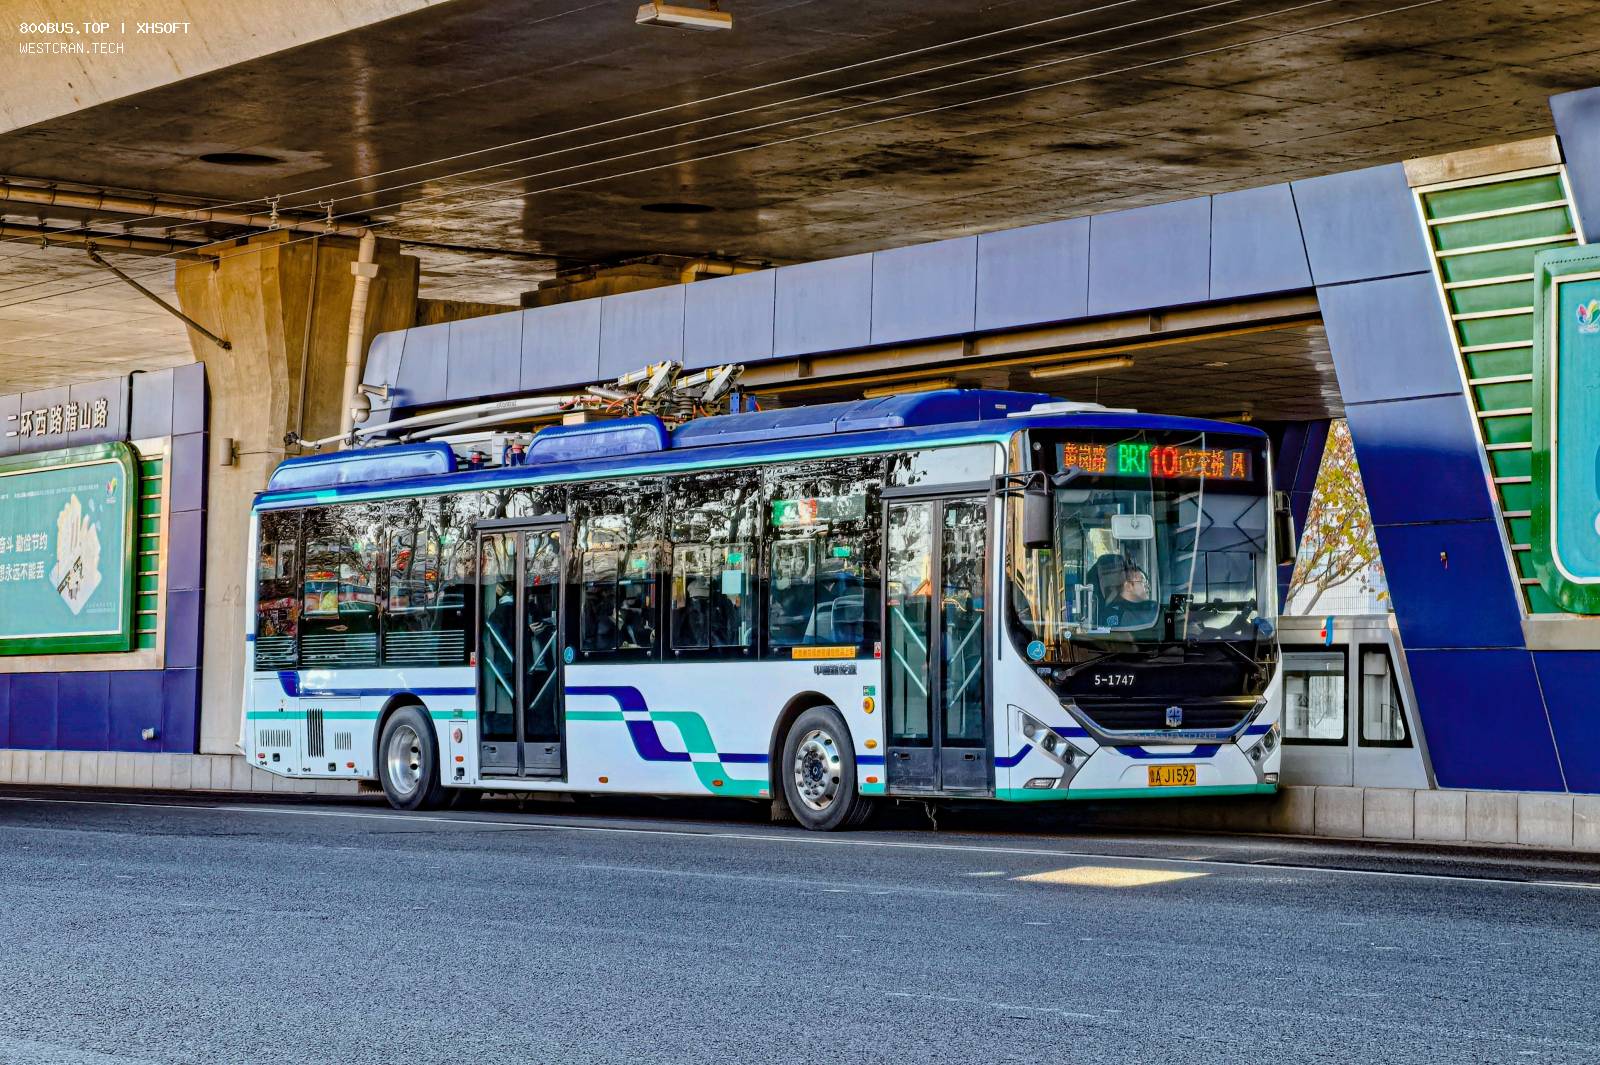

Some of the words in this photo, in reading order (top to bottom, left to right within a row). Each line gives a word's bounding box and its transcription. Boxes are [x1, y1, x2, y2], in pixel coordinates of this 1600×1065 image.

[6, 398, 108, 438] 二环西路腊山路
[1094, 674, 1136, 686] 5-1747
